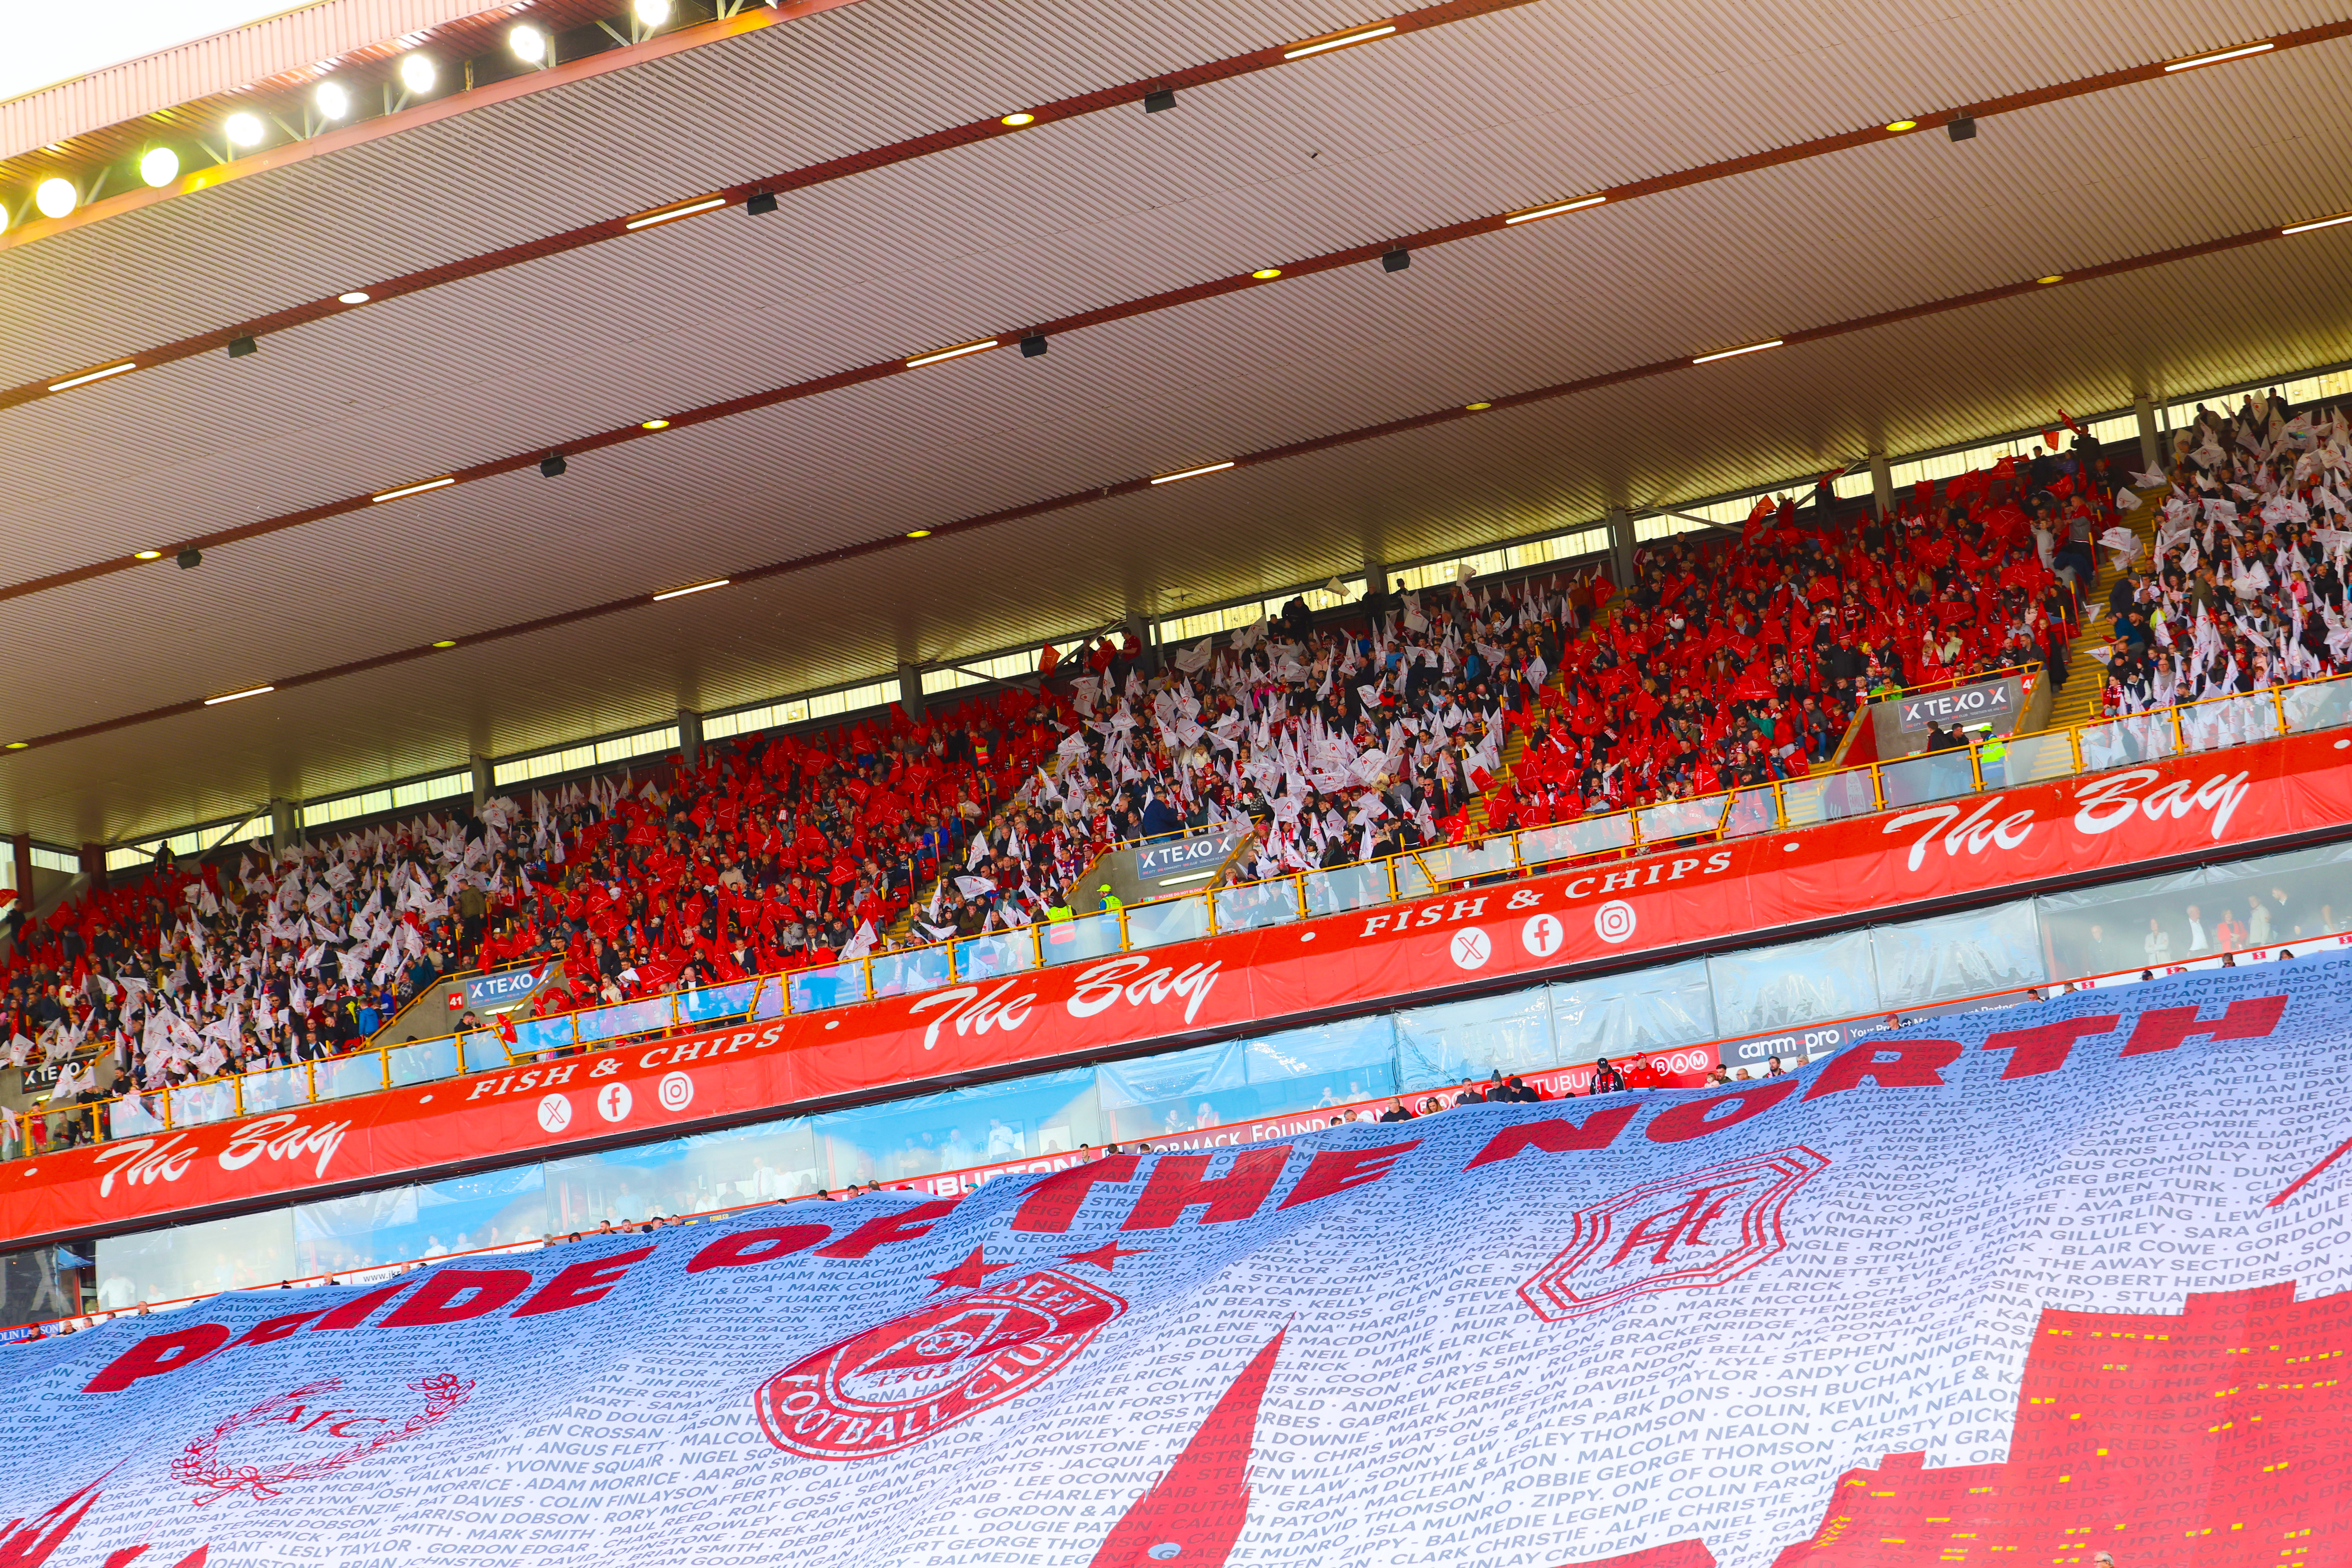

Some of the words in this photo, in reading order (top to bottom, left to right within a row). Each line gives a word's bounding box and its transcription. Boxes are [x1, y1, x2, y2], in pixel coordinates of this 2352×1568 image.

[1924, 692, 1984, 716] TEXO
[1882, 796, 2034, 872] The
[2074, 769, 2249, 839] Bay
[1160, 841, 1212, 864] TEXO
[1360, 897, 1488, 938] FISH
[1506, 889, 1543, 909] &
[1565, 851, 1732, 899] CHIPS
[486, 974, 533, 994] TEXO
[2126, 983, 2178, 997] FRED
[2184, 972, 2267, 988] FORBES
[2136, 989, 2207, 1004] ETHAN
[2213, 973, 2339, 994] EMMERSON
[450, 996, 462, 1006] 41
[909, 979, 1037, 1050] The
[1067, 955, 1222, 1024] Bay
[2118, 994, 2245, 1013] ALEXANDER
[466, 1064, 579, 1101] FISH
[590, 1058, 623, 1078] &
[639, 1025, 785, 1069] CHIPS
[2243, 1060, 2315, 1072] DOBIE
[2213, 1074, 2277, 1085] NEILL
[2218, 1091, 2320, 1107] CHARLIE
[686, 1198, 963, 1273] OF
[1012, 1138, 1425, 1234] THE
[1468, 994, 2290, 1170] NORTH
[2212, 1125, 2314, 1139] WILLIAM
[2177, 1141, 2250, 1151] LINDA
[94, 1133, 199, 1198] The
[219, 1114, 351, 1178] Bay
[2023, 1160, 2105, 1182] ANGUS
[2112, 1151, 2247, 1168] CONNOLLY
[2105, 1164, 2212, 1183] BRECHIN
[2084, 1181, 2152, 1198] EWEN
[2160, 1178, 2225, 1192] TURK
[2130, 1192, 2228, 1207] BEATTIE
[1826, 1211, 1912, 1226] (MARK)
[2081, 1205, 2193, 1226] STIRLING
[1802, 1226, 1899, 1238] WRIGHT
[1915, 1214, 1980, 1235] JOHN
[2050, 1223, 2165, 1241] GILLULEY
[2061, 1241, 2132, 1255] BLAIR
[2138, 1240, 2216, 1254] COWE
[2236, 1214, 2343, 1252] GORDON
[1868, 1230, 1958, 1251] RONNIE
[2038, 1257, 2085, 1270] THE
[2090, 1257, 2165, 1270] AWAY
[2170, 1251, 2279, 1271] SECTION
[2067, 1275, 2168, 1286] ROBERT
[1308, 1296, 1373, 1308] KELLY
[21, 1324, 58, 1338] LASON
[447, 1321, 501, 1332] CLARK
[1299, 1315, 1439, 1345] MACDONALD
[1611, 1320, 1798, 1343] BRACKENRIDGE
[1854, 1334, 2031, 1373] CUNNINGHAM
[31, 1368, 74, 1379] MANN
[634, 1365, 709, 1377] TAYLOR
[1825, 1364, 1931, 1396] BUCHAN
[40, 1392, 123, 1401] CAMERON
[606, 1410, 700, 1423] DOUGLAS
[291, 1441, 347, 1450] LOUIS
[1272, 1431, 1370, 1446] DOWNIE
[535, 1442, 607, 1456] ANGUS
[612, 1441, 669, 1456] FLETT
[506, 1460, 590, 1474] YVONNE
[592, 1454, 664, 1474] SQUAIR
[679, 1451, 739, 1465] NIGEL
[1292, 1443, 1435, 1480] WILLIAMSON
[1502, 1470, 1591, 1494] ROBBIE
[1597, 1448, 1695, 1480] GEORGE
[1702, 1440, 1834, 1460] THOMSON
[319, 1470, 391, 1482] BROWN
[1058, 1471, 1180, 1485] OCONNOR
[1612, 1474, 1663, 1497] ONE
[1669, 1467, 1703, 1482] OF
[1708, 1464, 1763, 1478] OUR
[1770, 1455, 1833, 1474] OWN
[422, 1479, 513, 1495] MORRICE
[524, 1478, 586, 1491] ADAM
[1018, 1489, 1124, 1501] CHARLEY
[452, 1494, 524, 1507] DAVIES
[539, 1496, 603, 1508] COLIN
[606, 1485, 719, 1508] FINLAYSON
[244, 1508, 304, 1518] CRAIG
[304, 1503, 401, 1517] MCKENZIE
[392, 1509, 498, 1524] HARRISON
[499, 1513, 590, 1524] DOBSON
[973, 1504, 1076, 1519] GORDON
[1080, 1506, 1097, 1516] &
[67, 1511, 141, 1531] GRAHAM
[97, 1521, 153, 1537] DAVID
[979, 1521, 1069, 1533] DOUGIE
[1073, 1521, 1152, 1532] PATON
[1426, 1514, 1547, 1547] BALMEDIE
[1667, 1515, 1757, 1537] DANIEL
[466, 1529, 524, 1540] MARK
[529, 1529, 596, 1540] SMITH
[603, 1526, 685, 1548] CHARLIE
[690, 1515, 778, 1533] ROWLEY
[1475, 1527, 1588, 1554] CHRISTIE
[1607, 1508, 1672, 1534] ALFIE
[278, 1544, 339, 1558] LESLY
[340, 1539, 412, 1557] TAYLOR
[427, 1543, 518, 1554] GORDON
[520, 1544, 590, 1554] EDGAR
